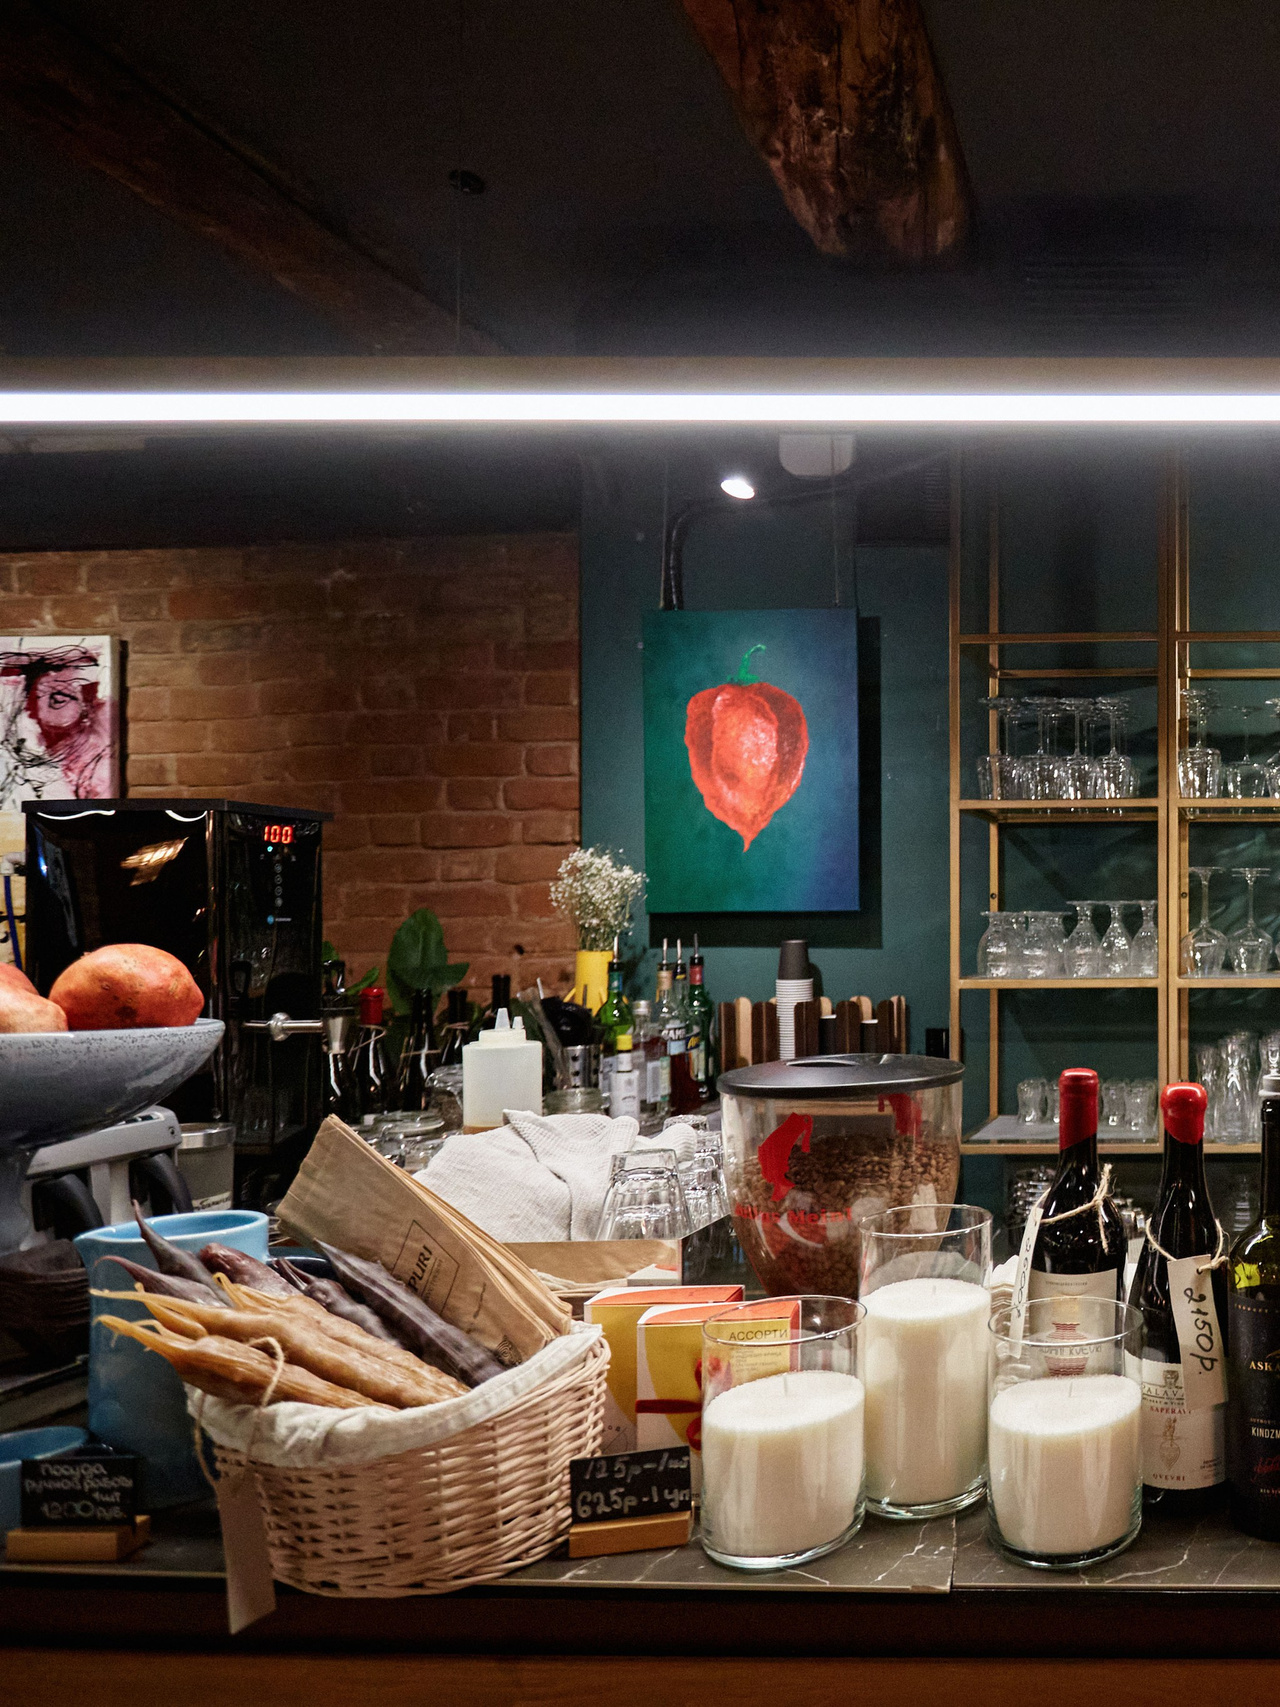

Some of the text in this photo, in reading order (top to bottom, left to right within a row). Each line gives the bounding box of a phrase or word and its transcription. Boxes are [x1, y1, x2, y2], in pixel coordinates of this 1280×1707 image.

[264, 825, 293, 844] 100
[787, 1206, 852, 1225] Meinl
[729, 1328, 788, 1341] АССОРТИ
